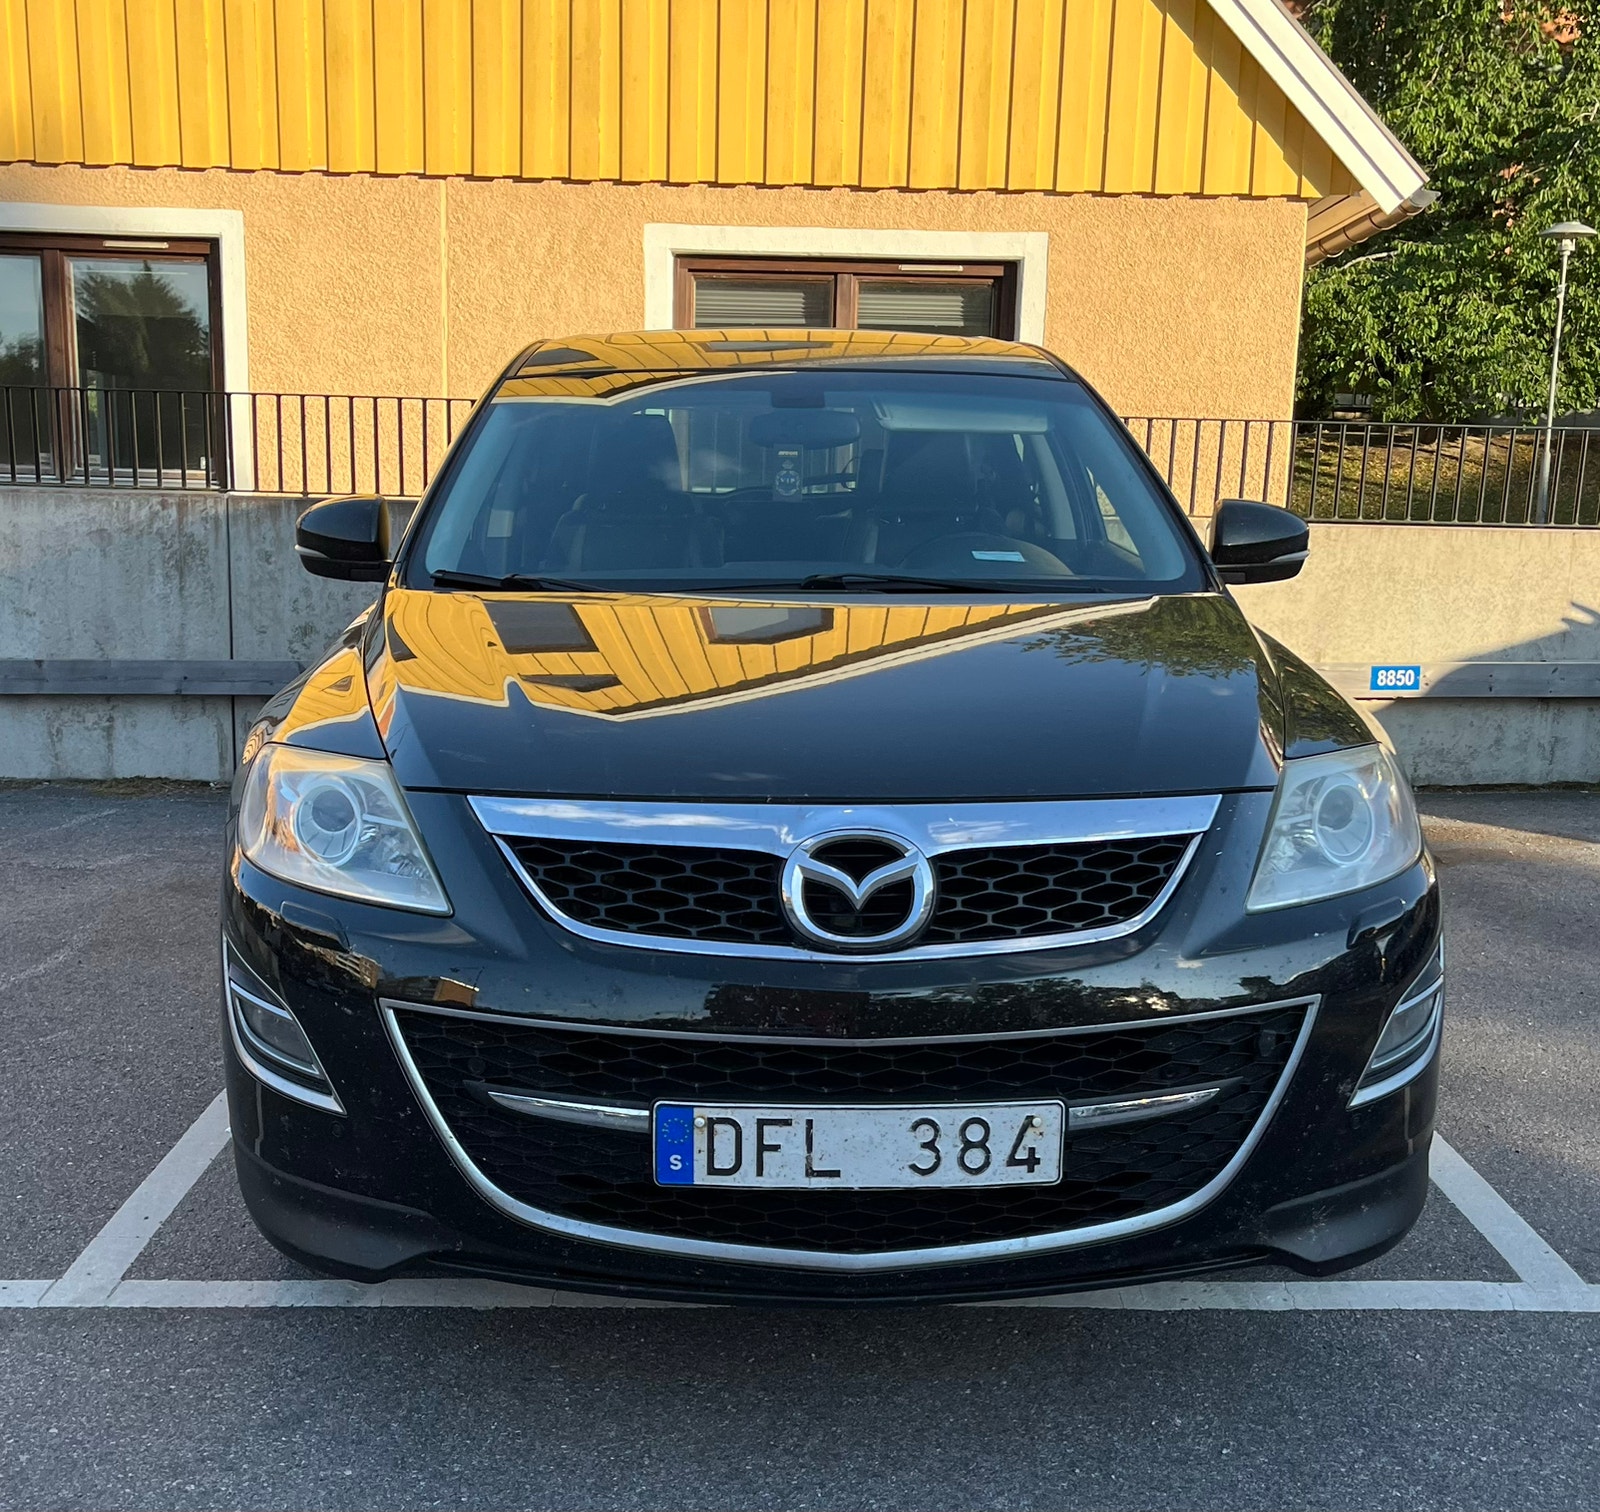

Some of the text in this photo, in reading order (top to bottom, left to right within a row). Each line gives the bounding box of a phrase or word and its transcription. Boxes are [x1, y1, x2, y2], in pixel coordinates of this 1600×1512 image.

[1377, 669, 1415, 686] 8850
[706, 1115, 1041, 1178] DFL 384
[669, 1154, 682, 1170] S
